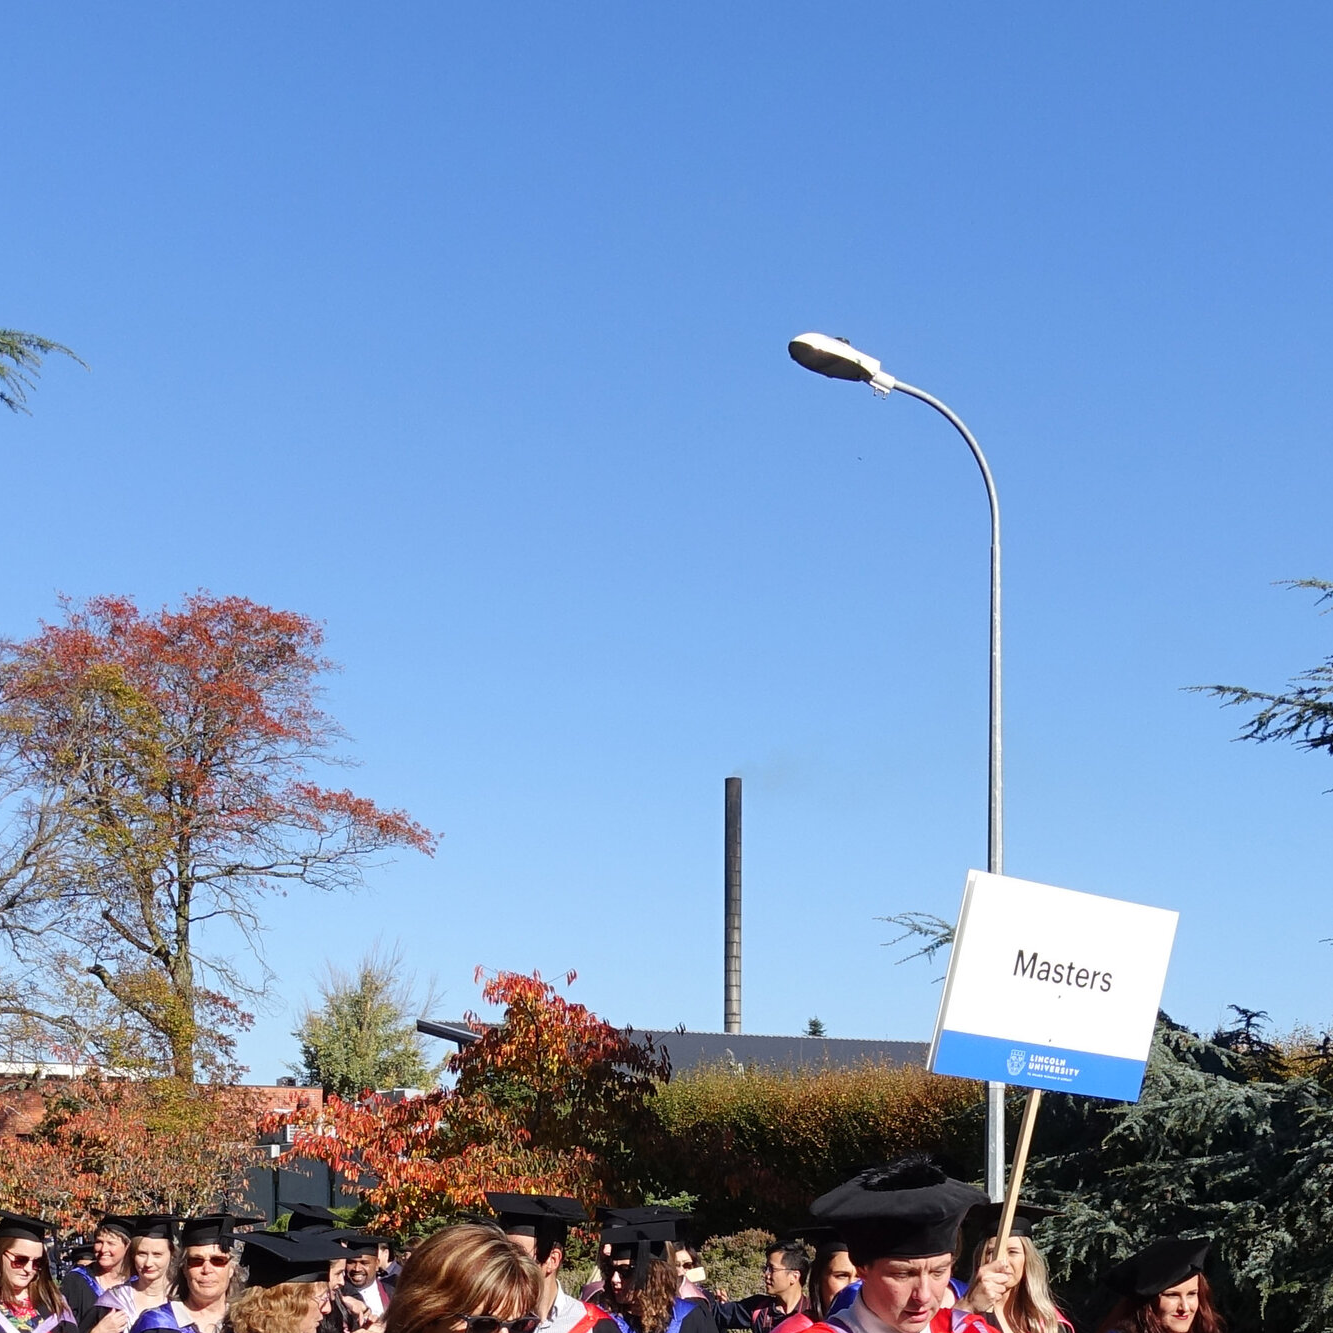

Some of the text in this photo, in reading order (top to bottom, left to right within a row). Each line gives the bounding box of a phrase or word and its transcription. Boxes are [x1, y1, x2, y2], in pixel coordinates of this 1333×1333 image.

[1013, 949, 1113, 992] Masters
[1029, 1054, 1066, 1066] LINCOLN
[1028, 1062, 1080, 1077] UNIVERSITY
